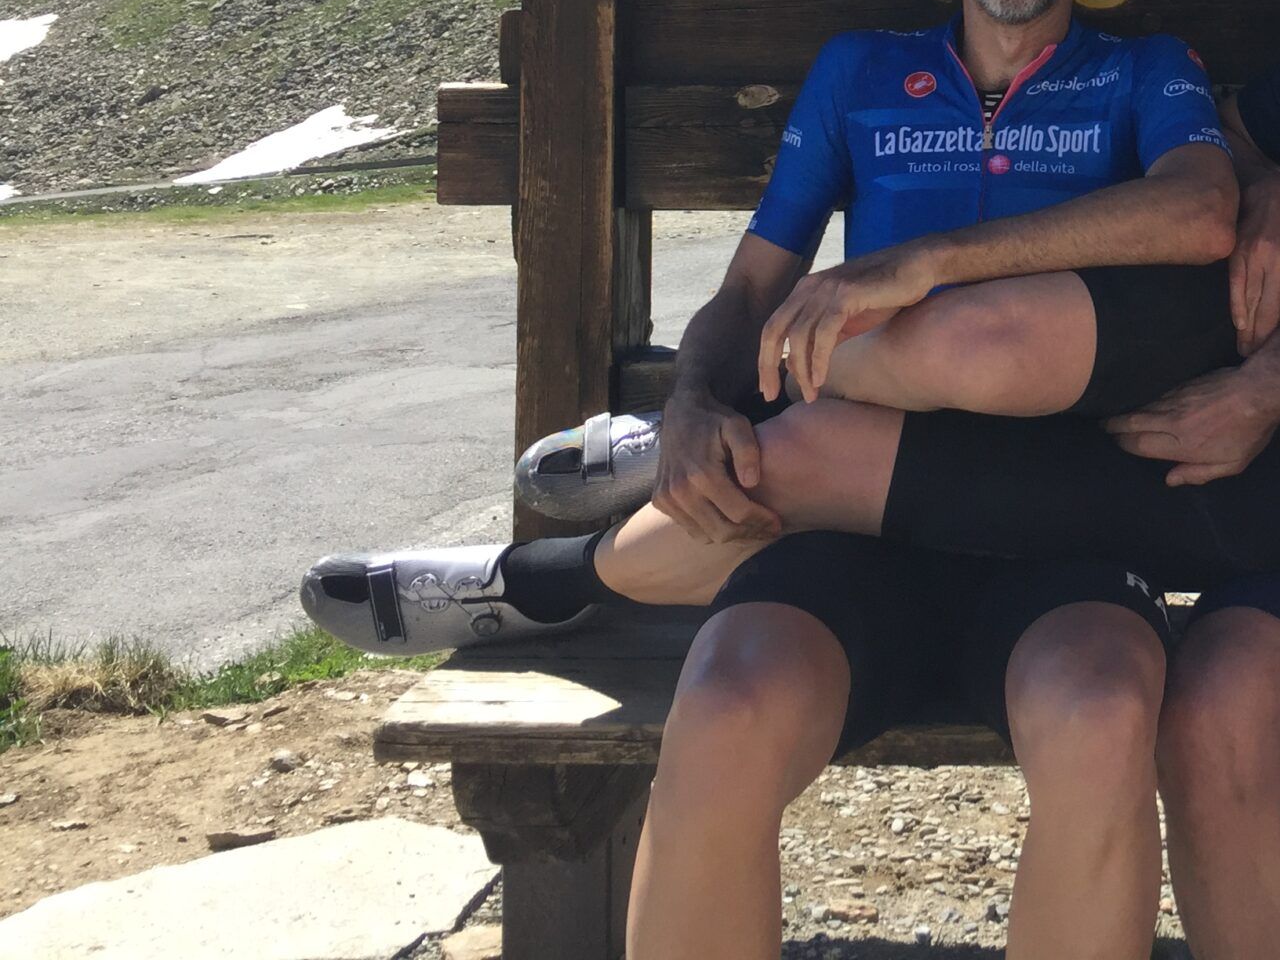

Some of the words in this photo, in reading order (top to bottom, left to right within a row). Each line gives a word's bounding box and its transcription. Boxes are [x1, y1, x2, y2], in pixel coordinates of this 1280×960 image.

[994, 125, 1045, 152] dello
[1046, 123, 1102, 158] Sport
[907, 161, 942, 173] Tutto
[1014, 159, 1047, 173] della
[1049, 161, 1076, 174] vita
